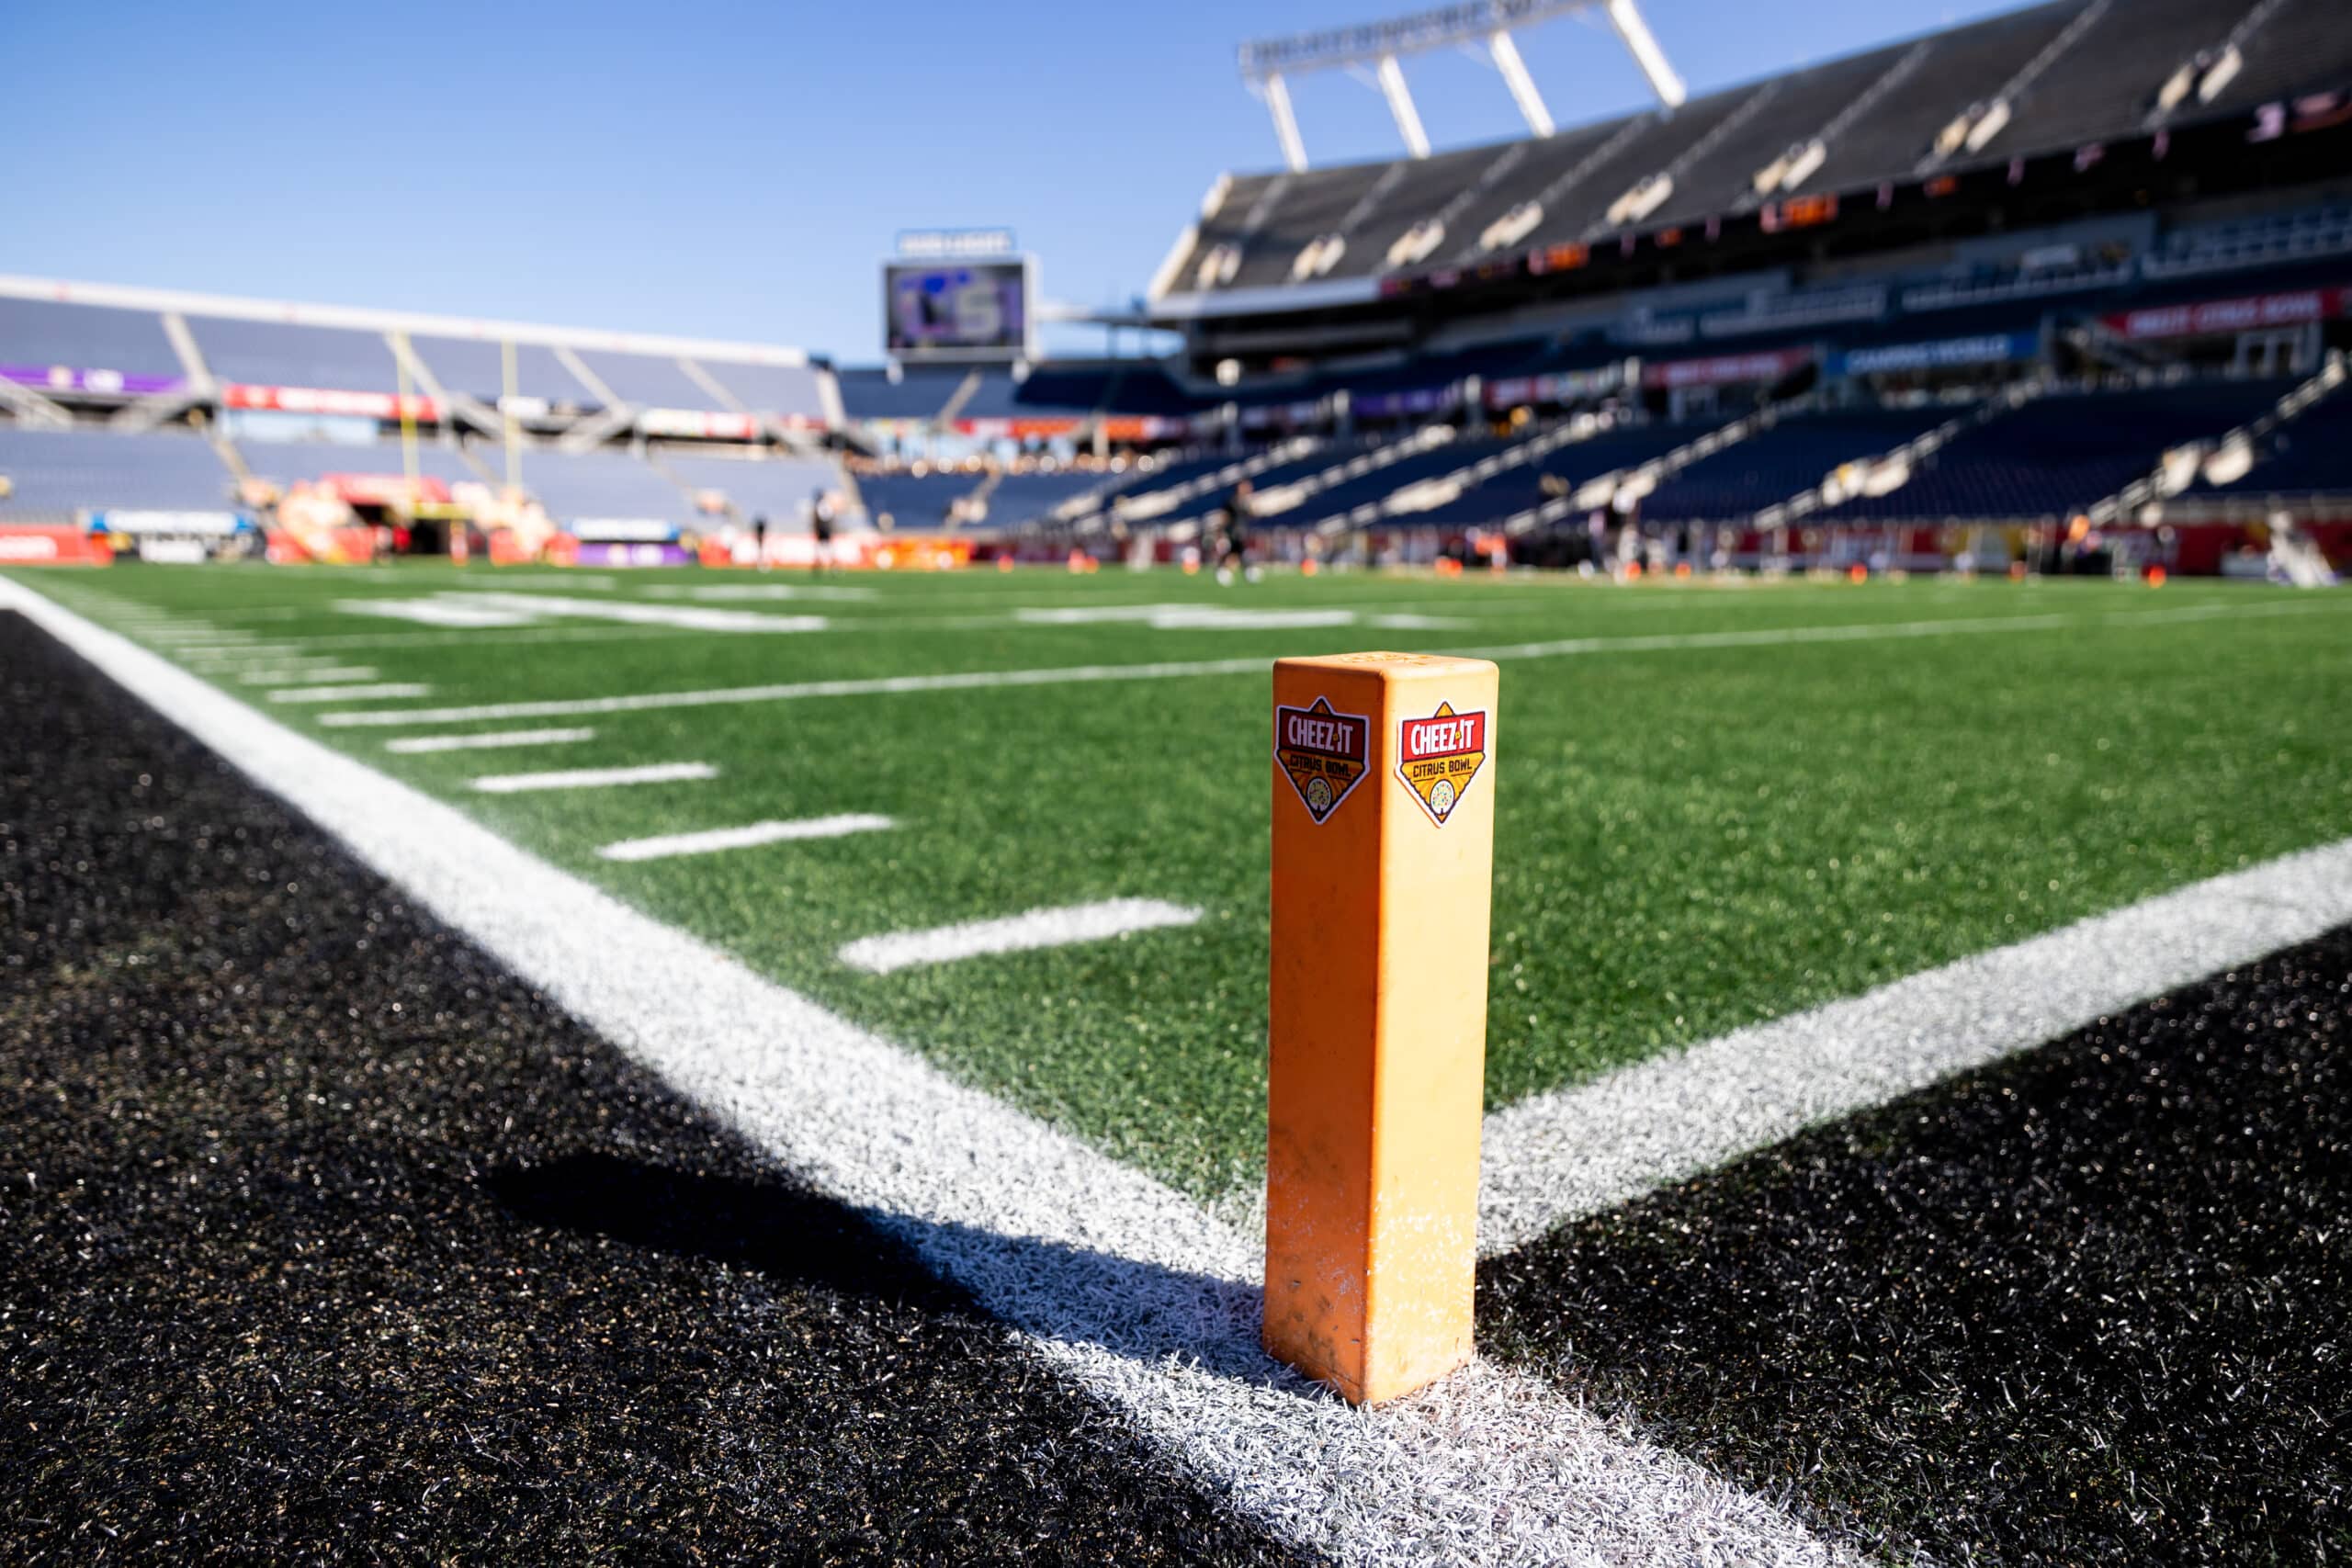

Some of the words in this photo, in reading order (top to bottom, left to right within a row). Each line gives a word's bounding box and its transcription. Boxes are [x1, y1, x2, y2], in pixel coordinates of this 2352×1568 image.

[1290, 754, 1322, 772] CITRUS
[1325, 760, 1352, 776] BOWL
[1413, 761, 1445, 778] CITRUS
[1448, 757, 1473, 773] BOWL
